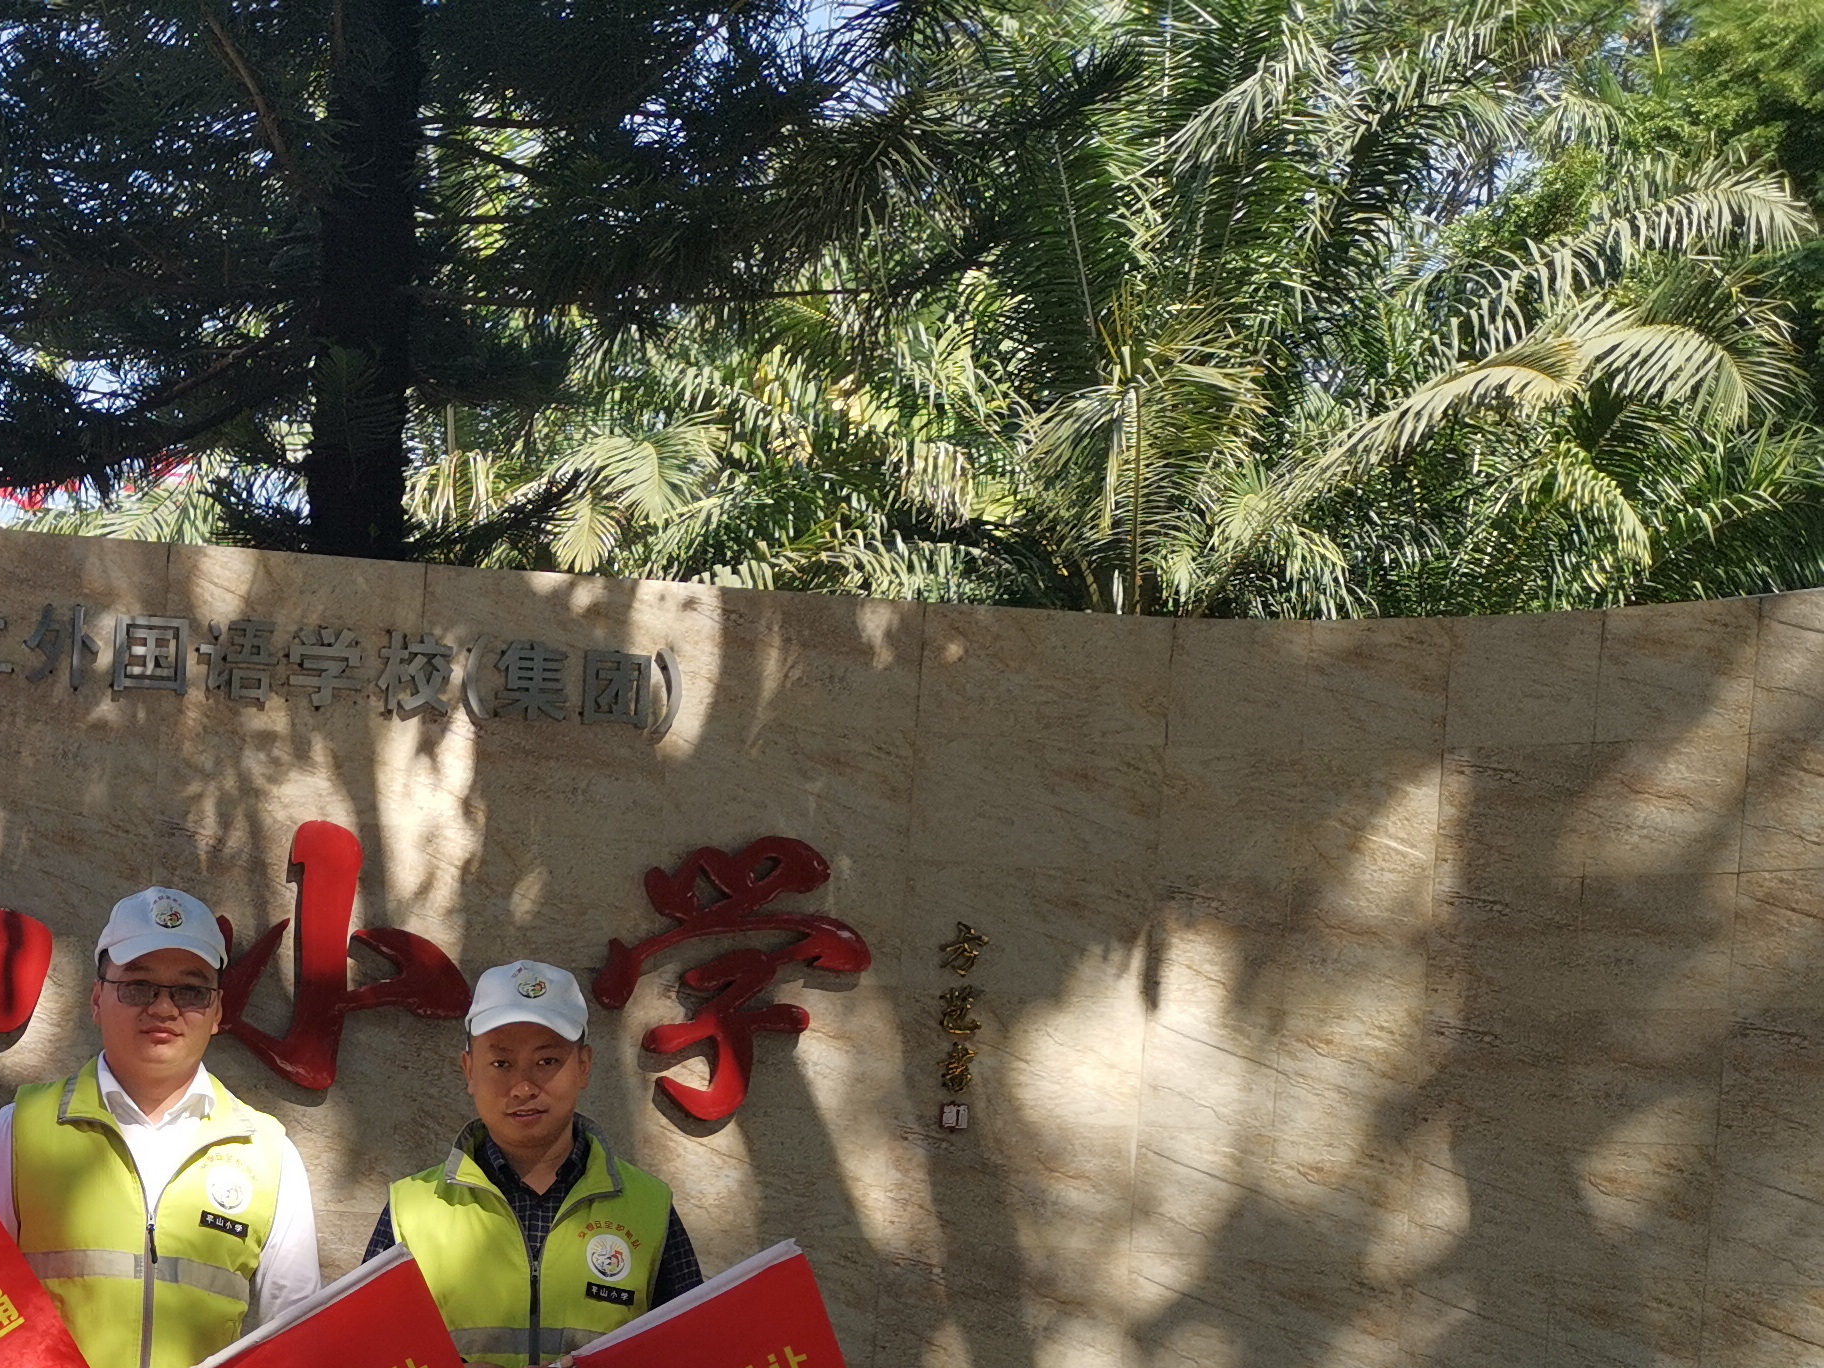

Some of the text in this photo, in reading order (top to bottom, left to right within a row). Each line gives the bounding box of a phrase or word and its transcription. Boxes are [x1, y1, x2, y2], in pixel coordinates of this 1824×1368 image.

[205, 1213, 243, 1233] 平山小学
[591, 1285, 629, 1301] 平山小学
